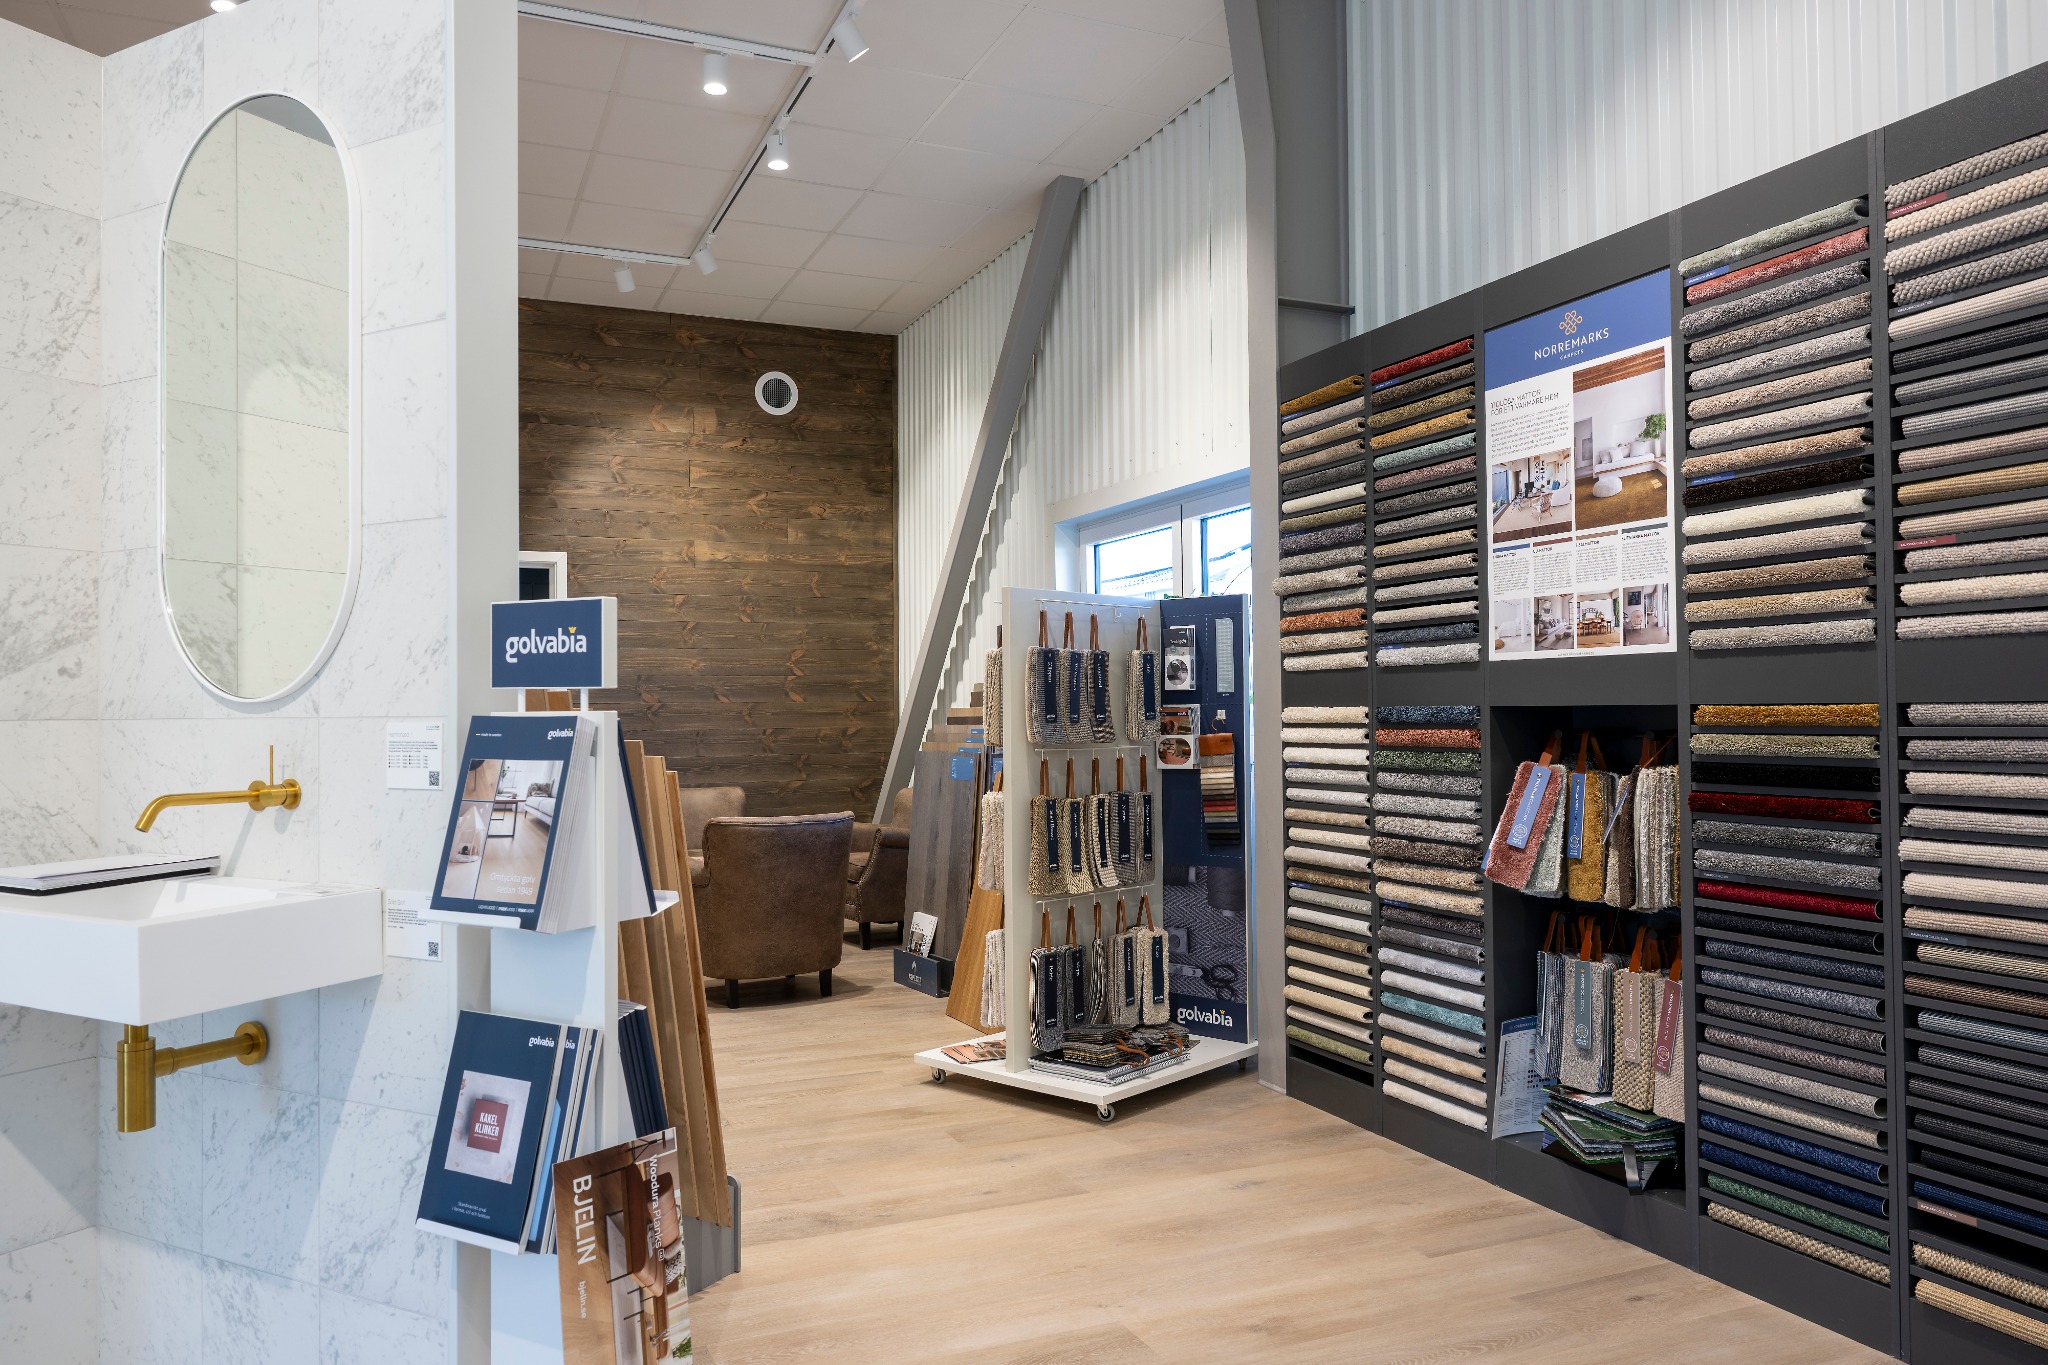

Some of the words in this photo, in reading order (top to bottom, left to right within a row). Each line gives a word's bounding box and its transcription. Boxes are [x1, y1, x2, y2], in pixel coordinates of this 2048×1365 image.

[1534, 327, 1609, 361] NORREMARKS
[505, 626, 587, 663] golvabia
[547, 728, 574, 740] golvabia
[490, 872, 521, 884] Omtyckta
[521, 874, 536, 885] golv
[496, 886, 516, 894] sedan
[517, 887, 534, 896] 1949
[1177, 1006, 1233, 1028] golvabia
[528, 1036, 555, 1048] golvabia
[474, 1122, 500, 1137] KLINKER
[479, 1112, 498, 1125] KAKEL
[649, 1154, 660, 1210] Woodura
[573, 1174, 597, 1266] BJELIN
[653, 1209, 662, 1249] Planks
[578, 1280, 587, 1319] bjelin.se
